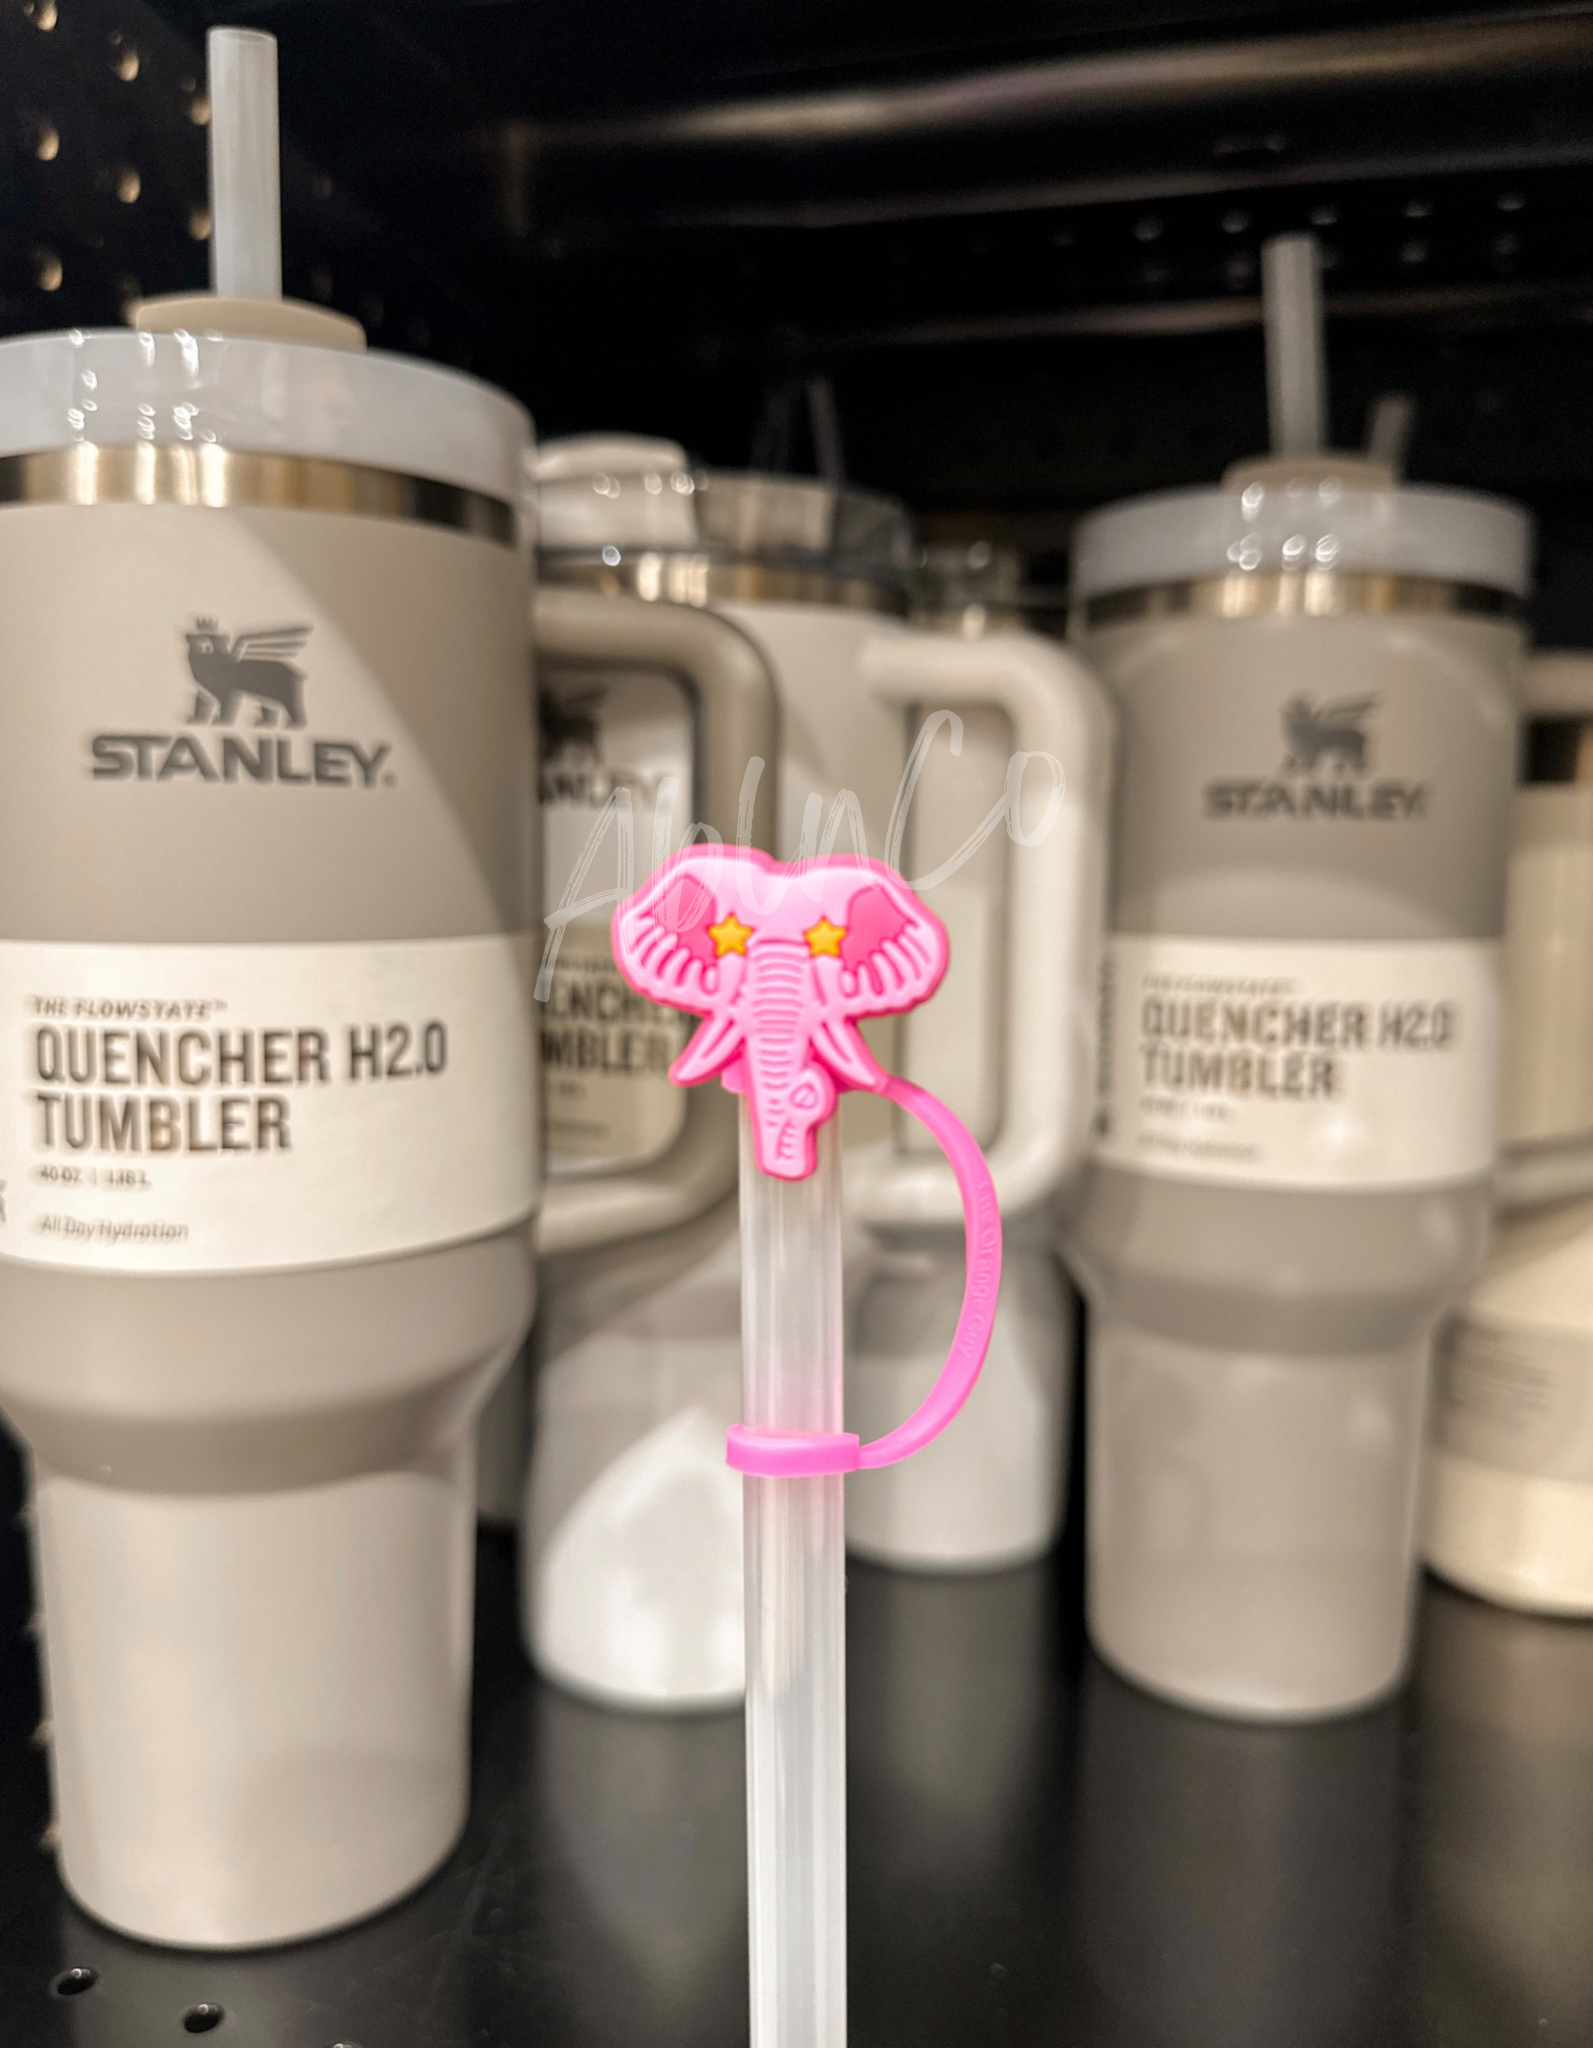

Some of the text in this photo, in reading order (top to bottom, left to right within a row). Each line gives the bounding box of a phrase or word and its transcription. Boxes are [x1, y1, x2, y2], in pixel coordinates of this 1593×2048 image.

[1207, 782, 1426, 819] STANLEY
[33, 995, 68, 1017] THE
[1142, 1001, 1367, 1048] QUENCHER
[36, 1020, 448, 1086] QUENCHER H2.0
[1142, 1046, 1337, 1097] TUMBLER
[36, 1093, 293, 1152] TUMBLER
[64, 1216, 95, 1240] Day
